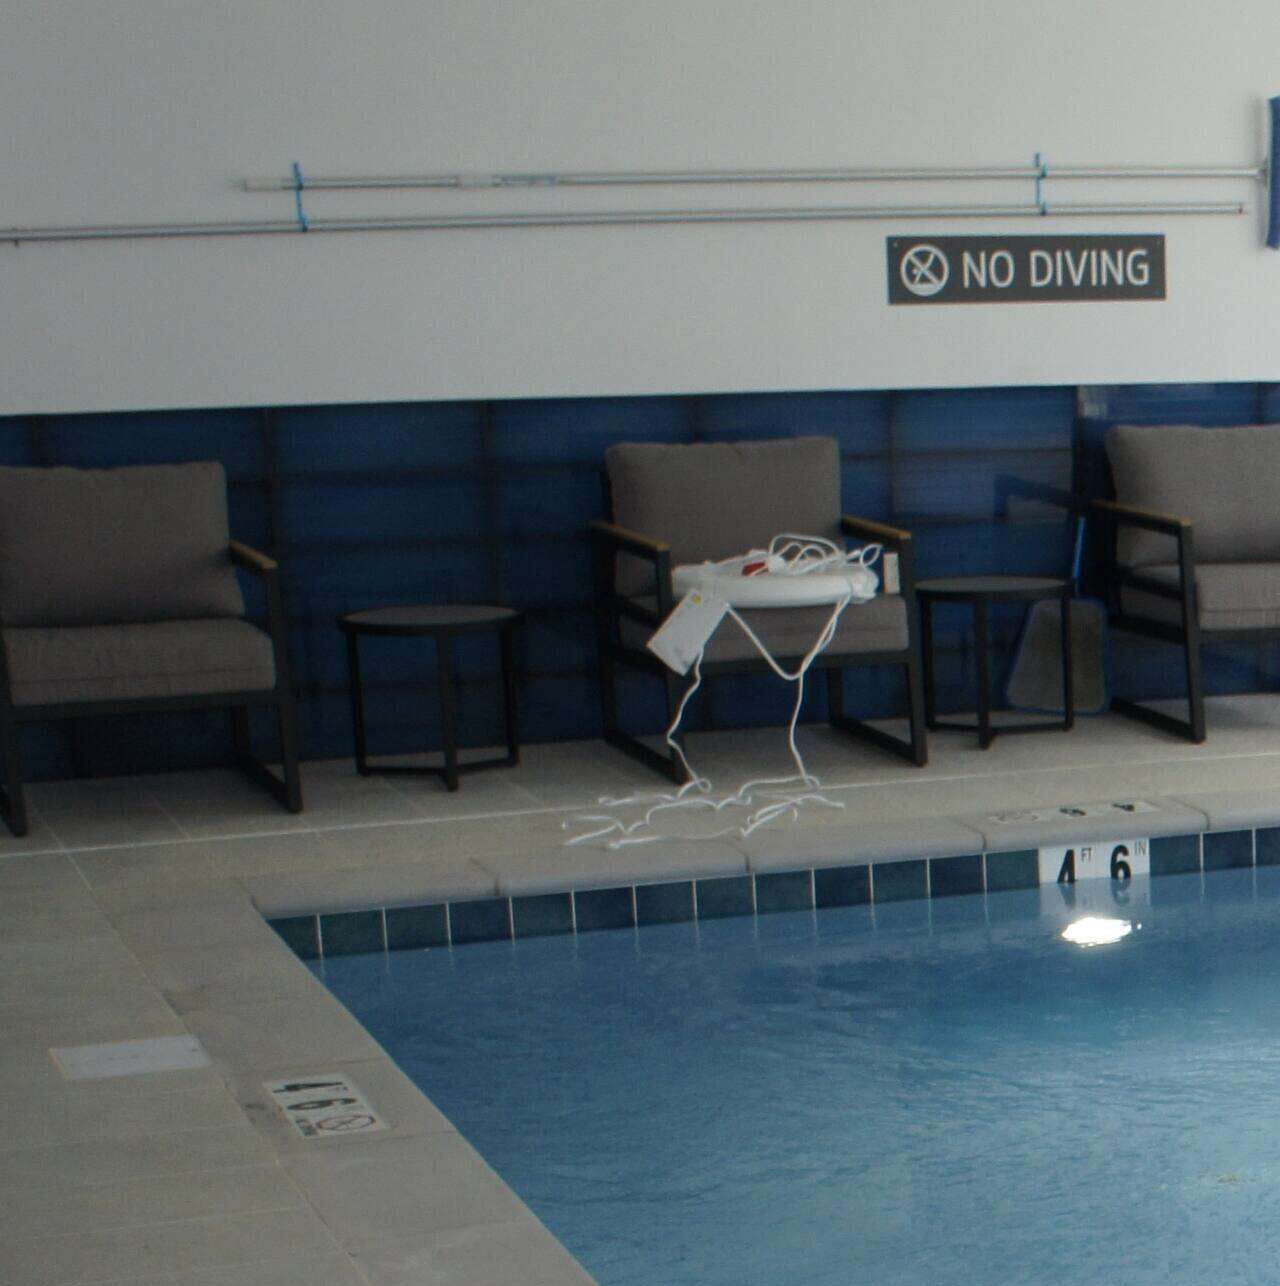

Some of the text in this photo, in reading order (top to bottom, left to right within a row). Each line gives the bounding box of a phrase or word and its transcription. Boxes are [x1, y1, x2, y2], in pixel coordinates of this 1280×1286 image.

[962, 249, 1149, 288] NO DIVING
[1110, 845, 1131, 880] 6
